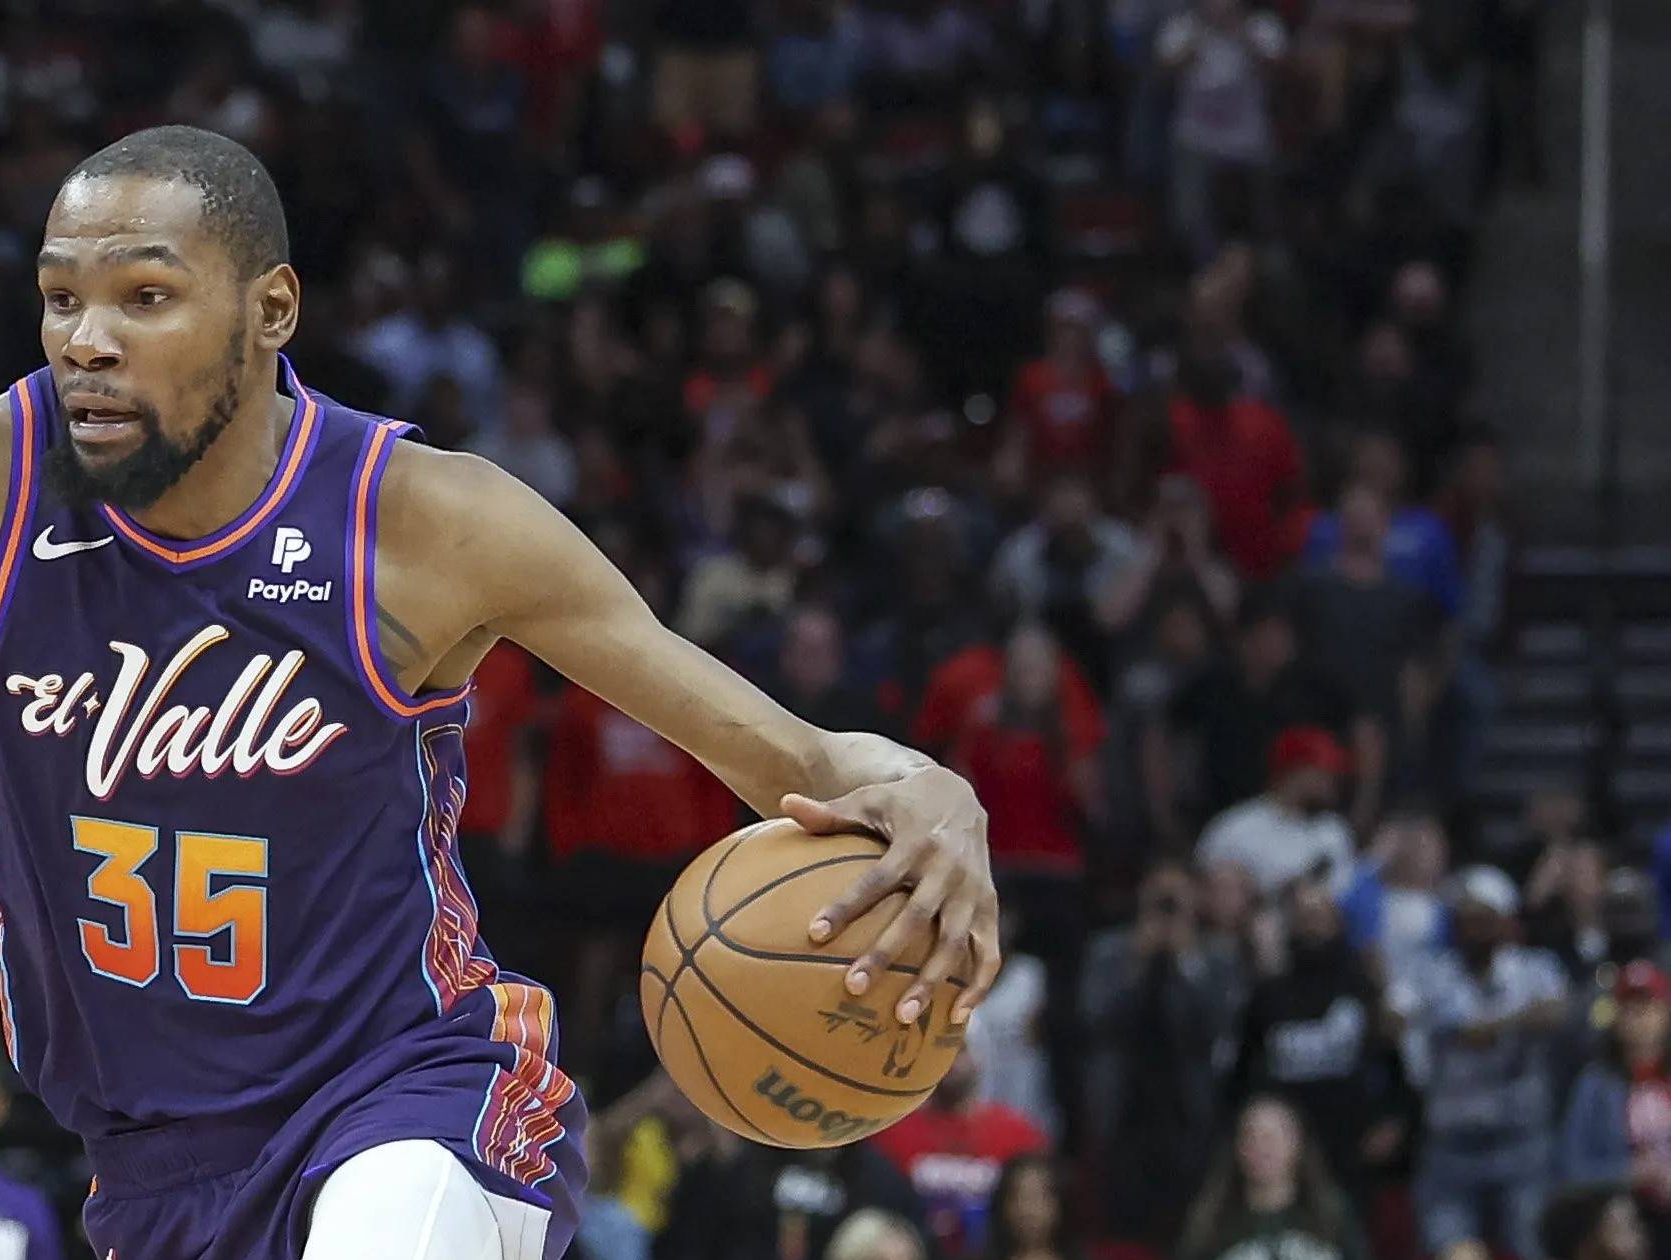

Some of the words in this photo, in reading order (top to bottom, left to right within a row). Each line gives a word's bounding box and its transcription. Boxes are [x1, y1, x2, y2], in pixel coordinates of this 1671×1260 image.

[247, 578, 332, 603] PayPal
[6, 672, 97, 735] El
[86, 624, 347, 800] Valle
[70, 815, 268, 1006] 35
